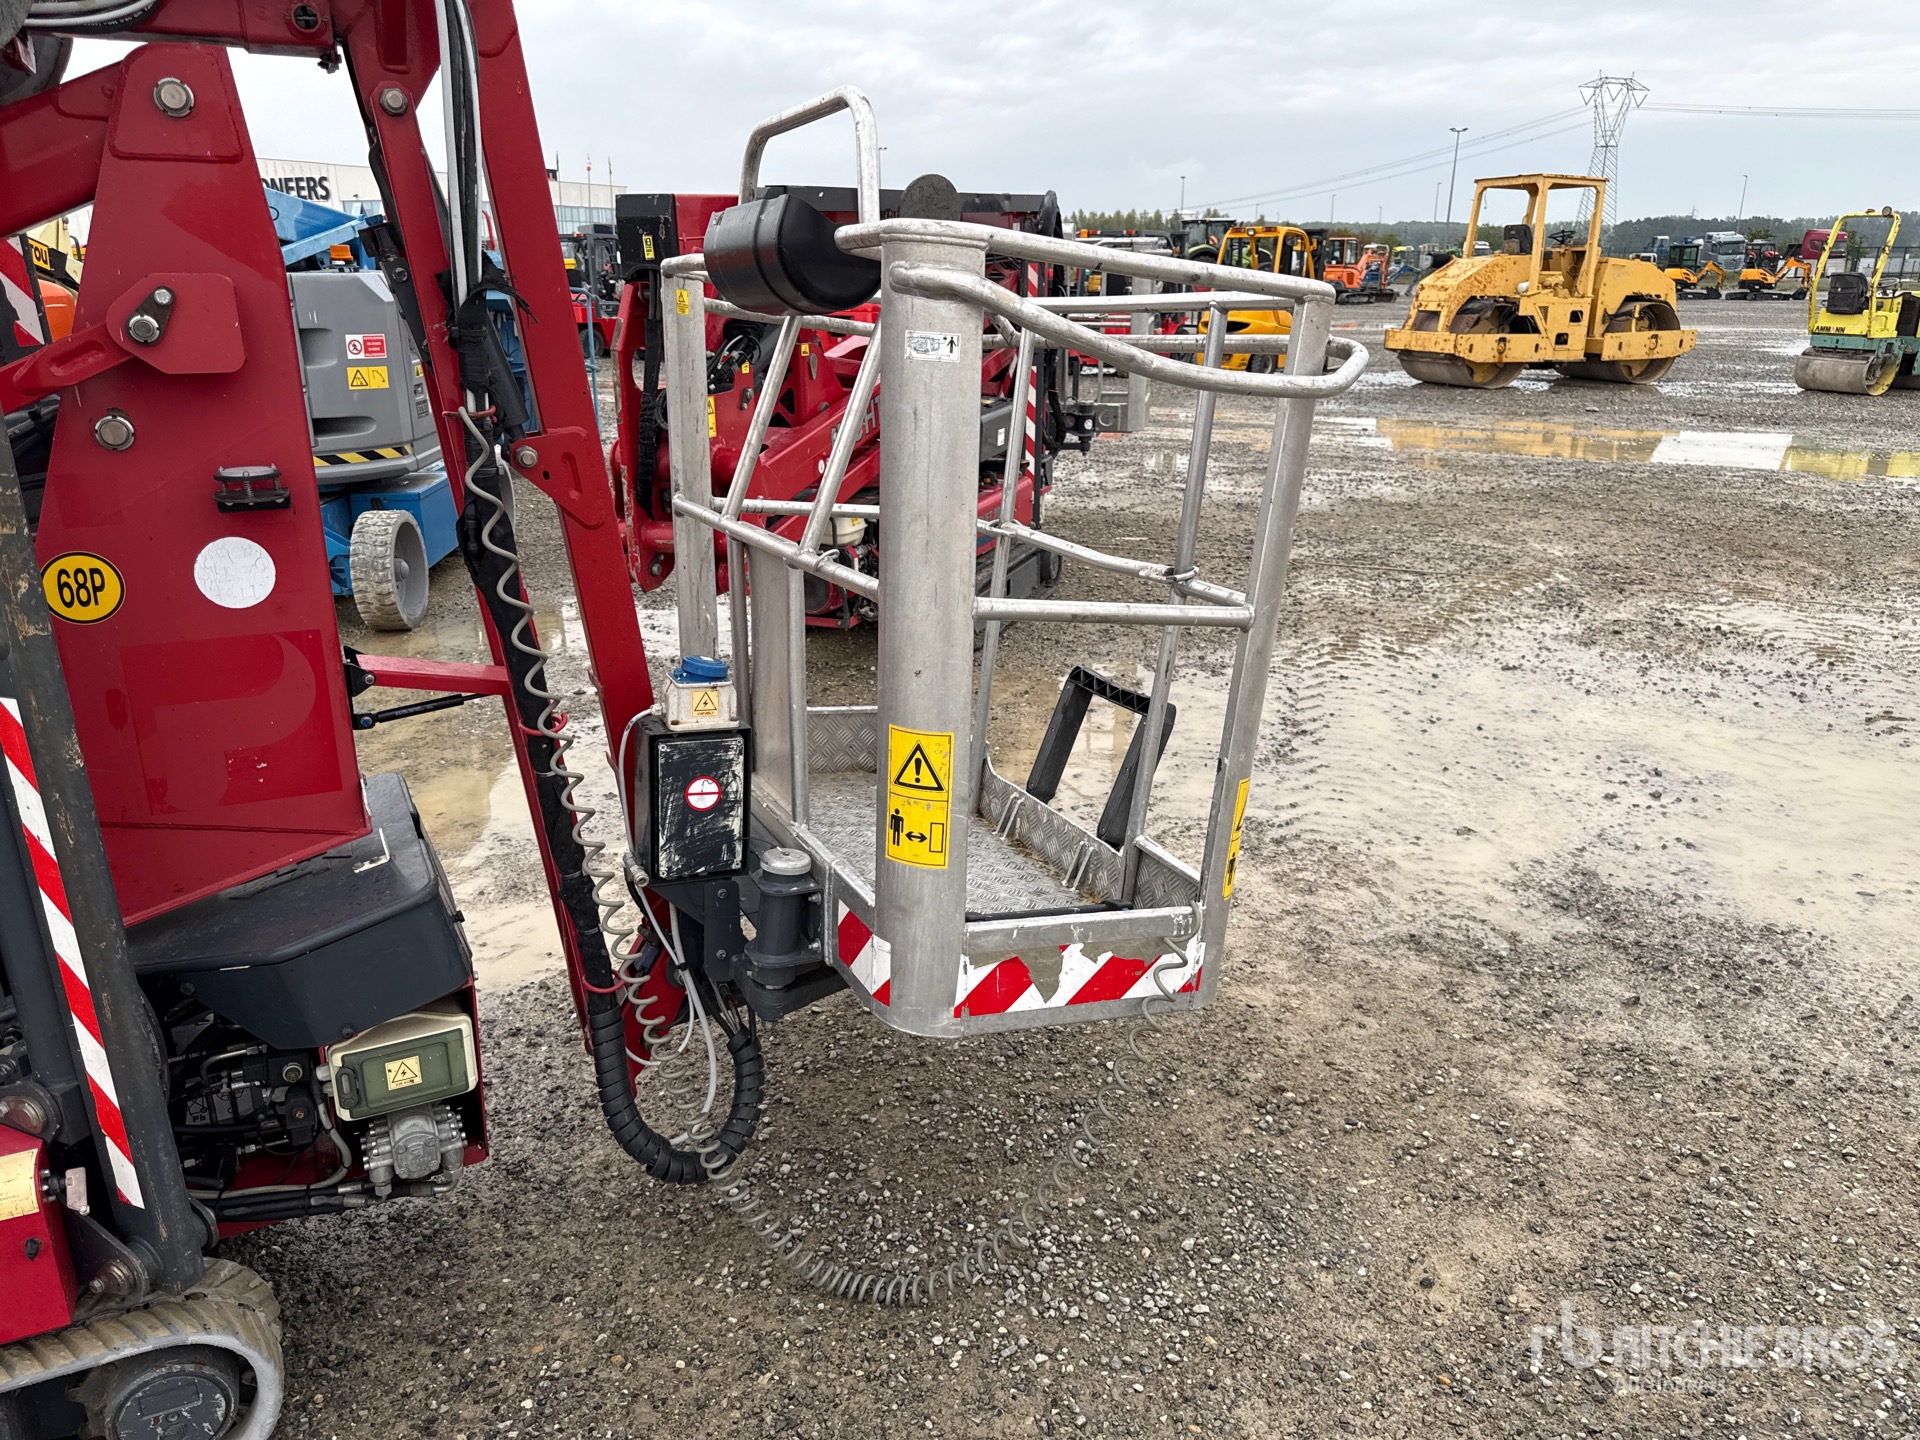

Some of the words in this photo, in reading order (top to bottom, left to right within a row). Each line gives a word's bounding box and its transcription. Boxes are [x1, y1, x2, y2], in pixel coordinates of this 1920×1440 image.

[30, 244, 49, 266] OU
[1815, 325, 1845, 333] AMMANN
[57, 567, 106, 609] 68P
[192, 1114, 206, 1122] Pb
